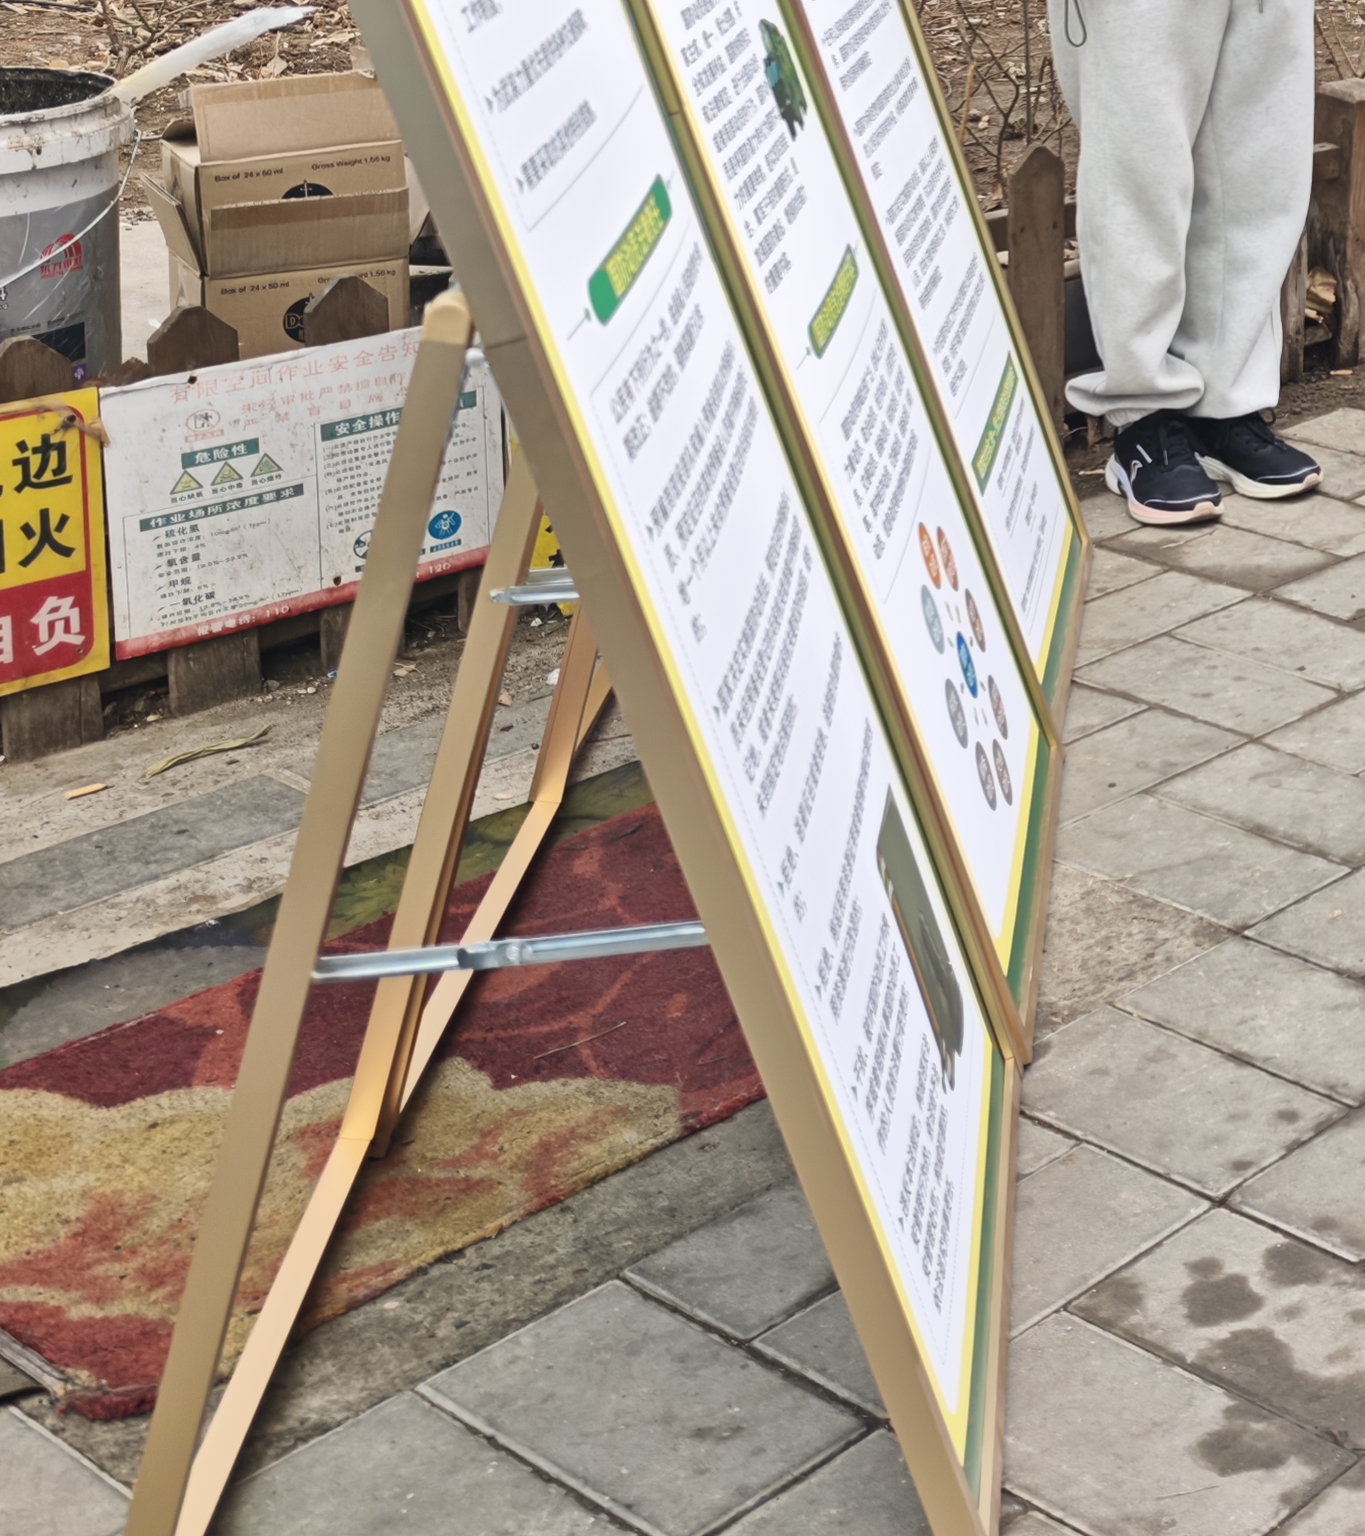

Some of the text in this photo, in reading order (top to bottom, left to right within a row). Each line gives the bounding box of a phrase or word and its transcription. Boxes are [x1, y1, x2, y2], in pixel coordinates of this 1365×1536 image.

[214, 173, 231, 182] Box
[194, 443, 249, 465] 危险性
[149, 487, 296, 529] 作业场所浓度要求
[164, 523, 201, 539] 硫化氢
[428, 562, 452, 575] 120
